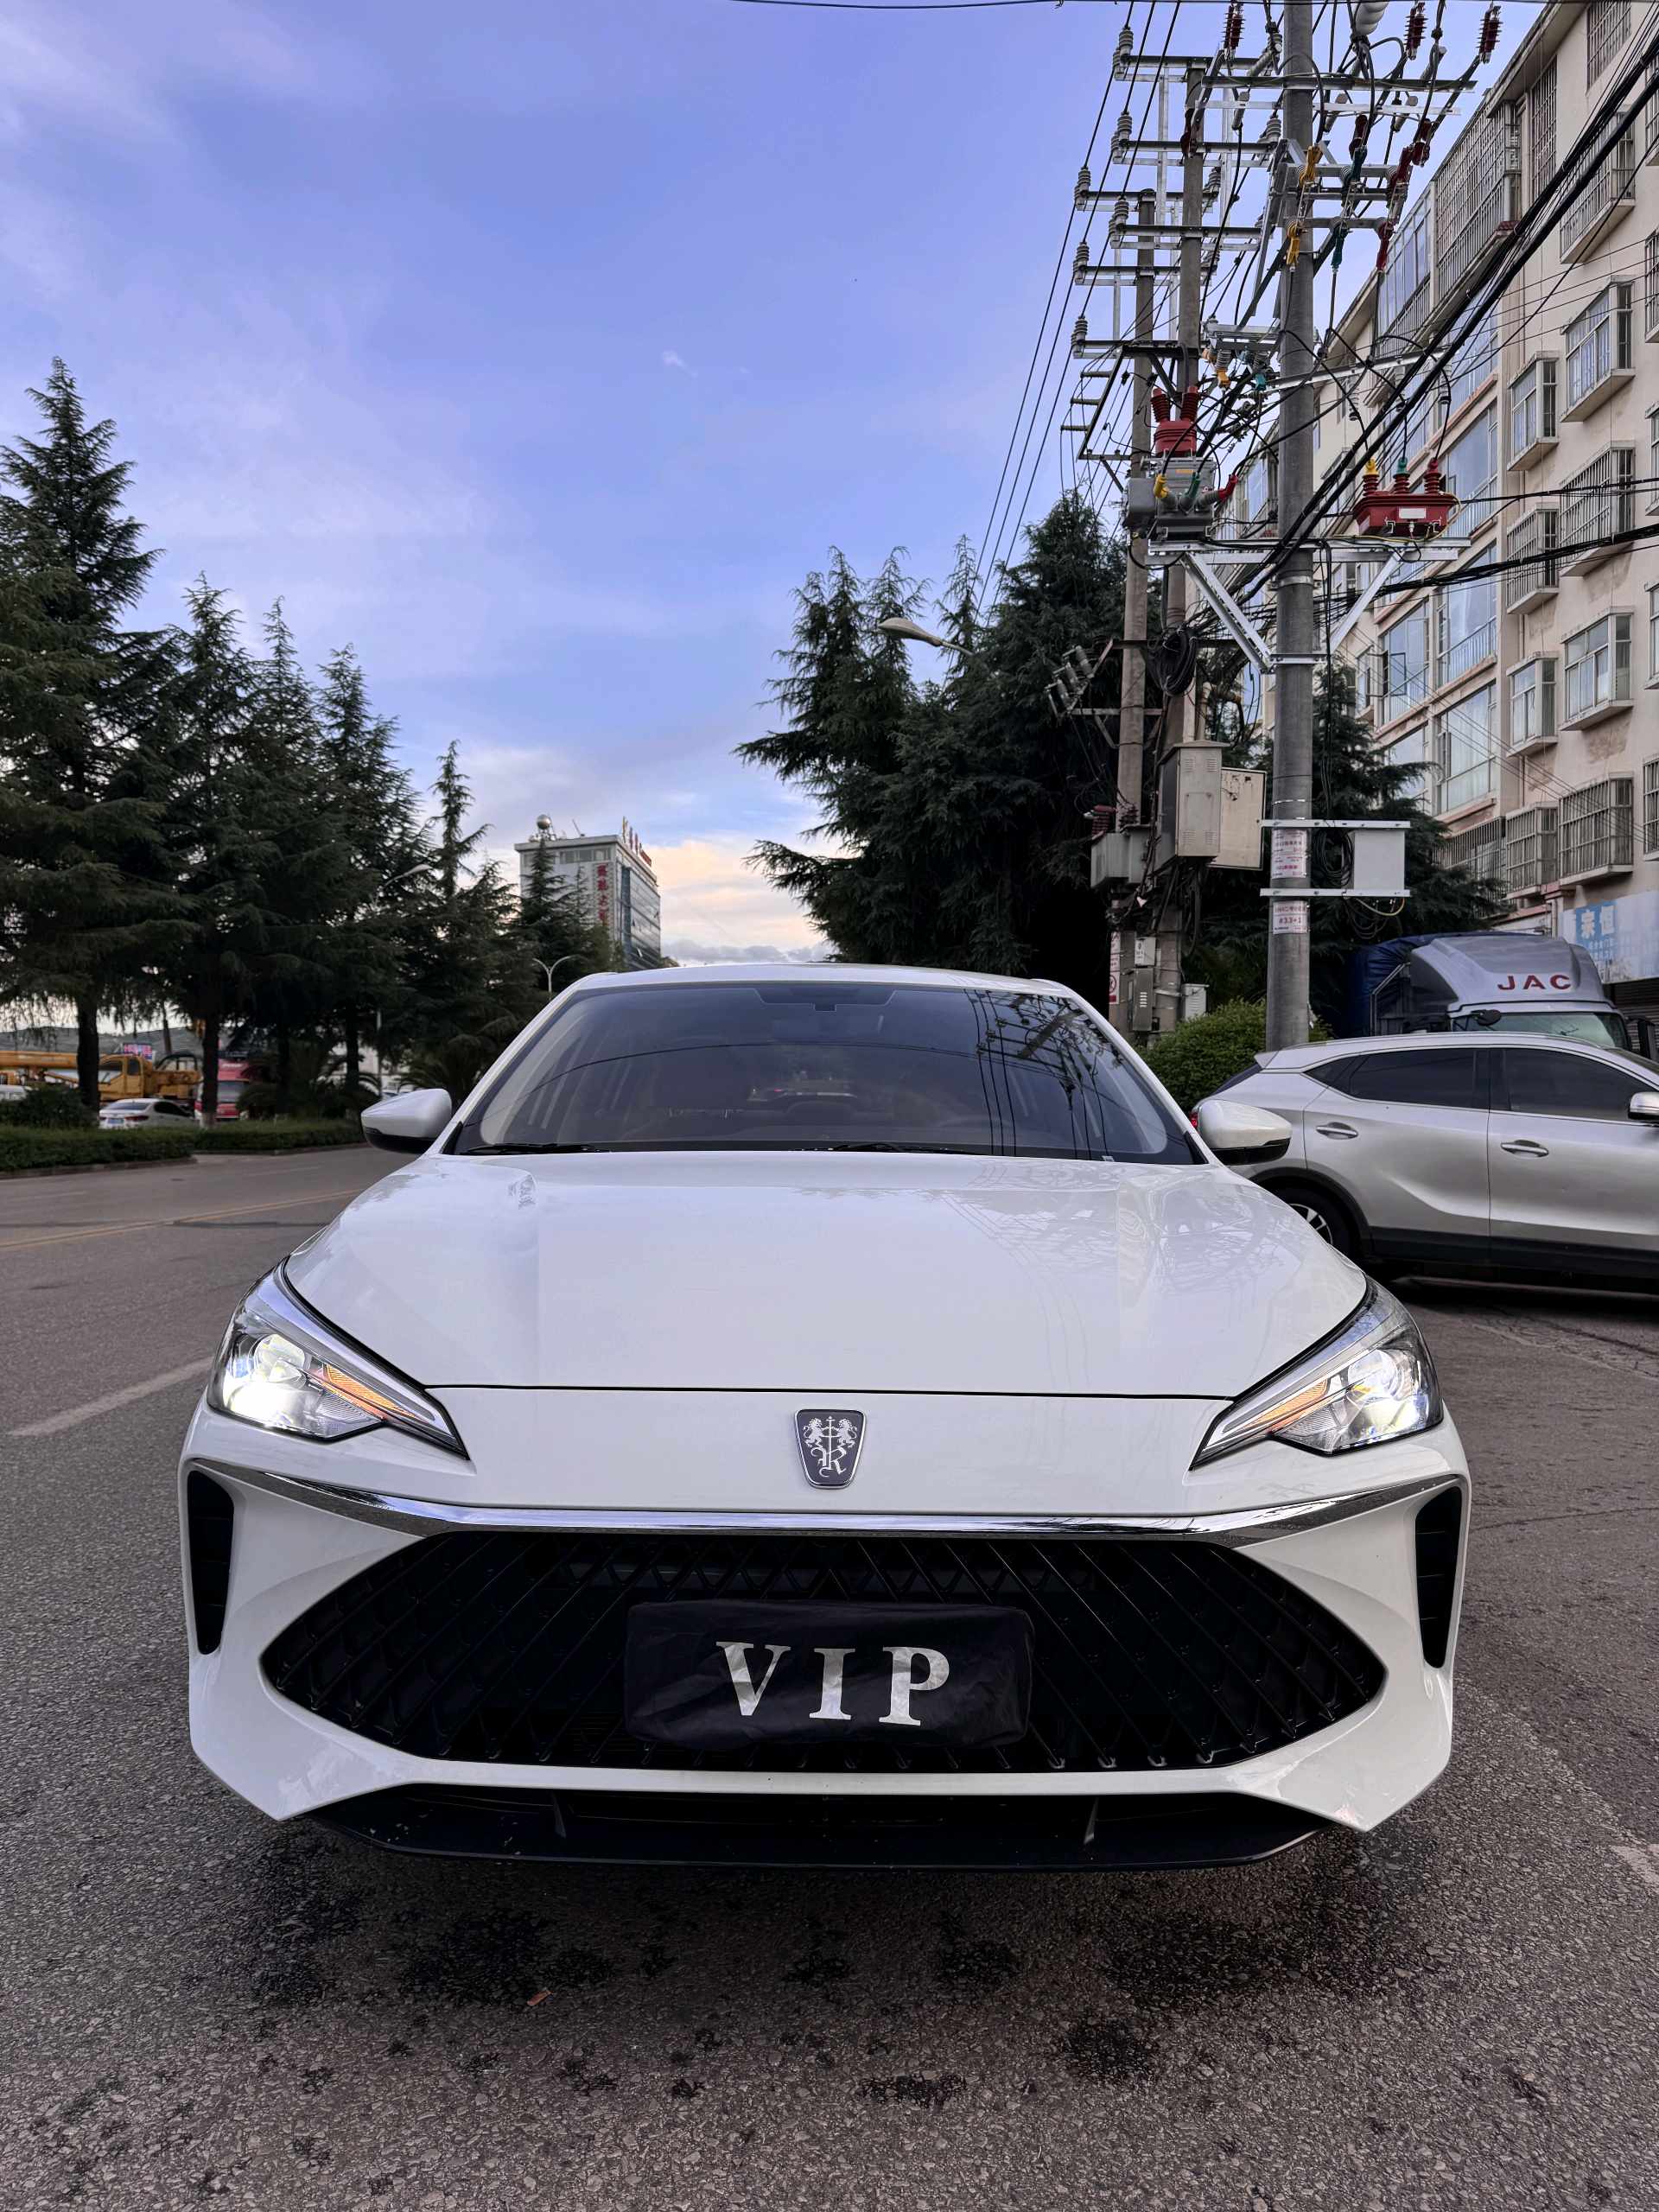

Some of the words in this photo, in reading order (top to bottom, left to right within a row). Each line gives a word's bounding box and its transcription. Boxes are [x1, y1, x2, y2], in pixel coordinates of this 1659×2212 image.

[1497, 975, 1572, 990] JAC
[811, 1445, 847, 1477] R
[715, 1642, 950, 1726] VIP
